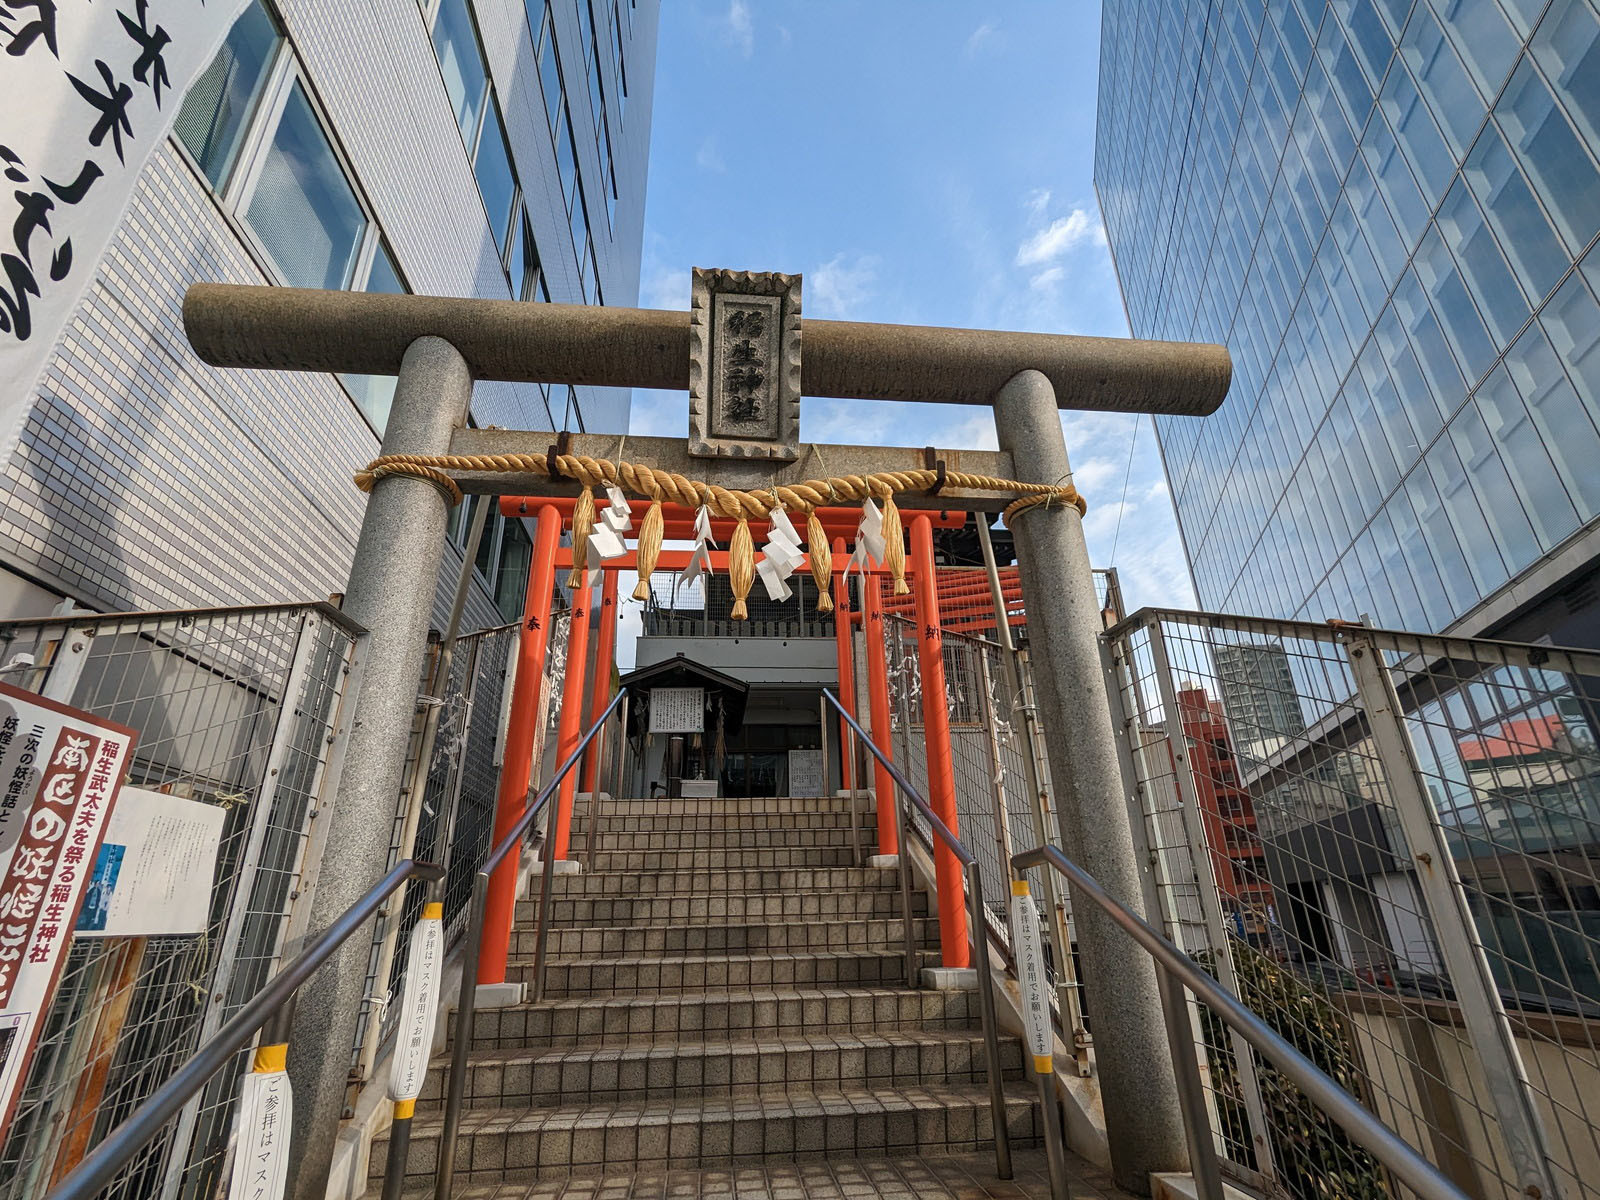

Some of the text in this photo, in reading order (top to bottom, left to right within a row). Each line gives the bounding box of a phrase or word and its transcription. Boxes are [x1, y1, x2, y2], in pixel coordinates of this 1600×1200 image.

[527, 616, 541, 631] 奉
[28, 739, 120, 963] 稲生武太夫を祭る稲生神社
[403, 919, 439, 1094] ご参拝はマスク着用でお願いします
[1019, 897, 1045, 1052] ご参拝はマスク着用でお願いします
